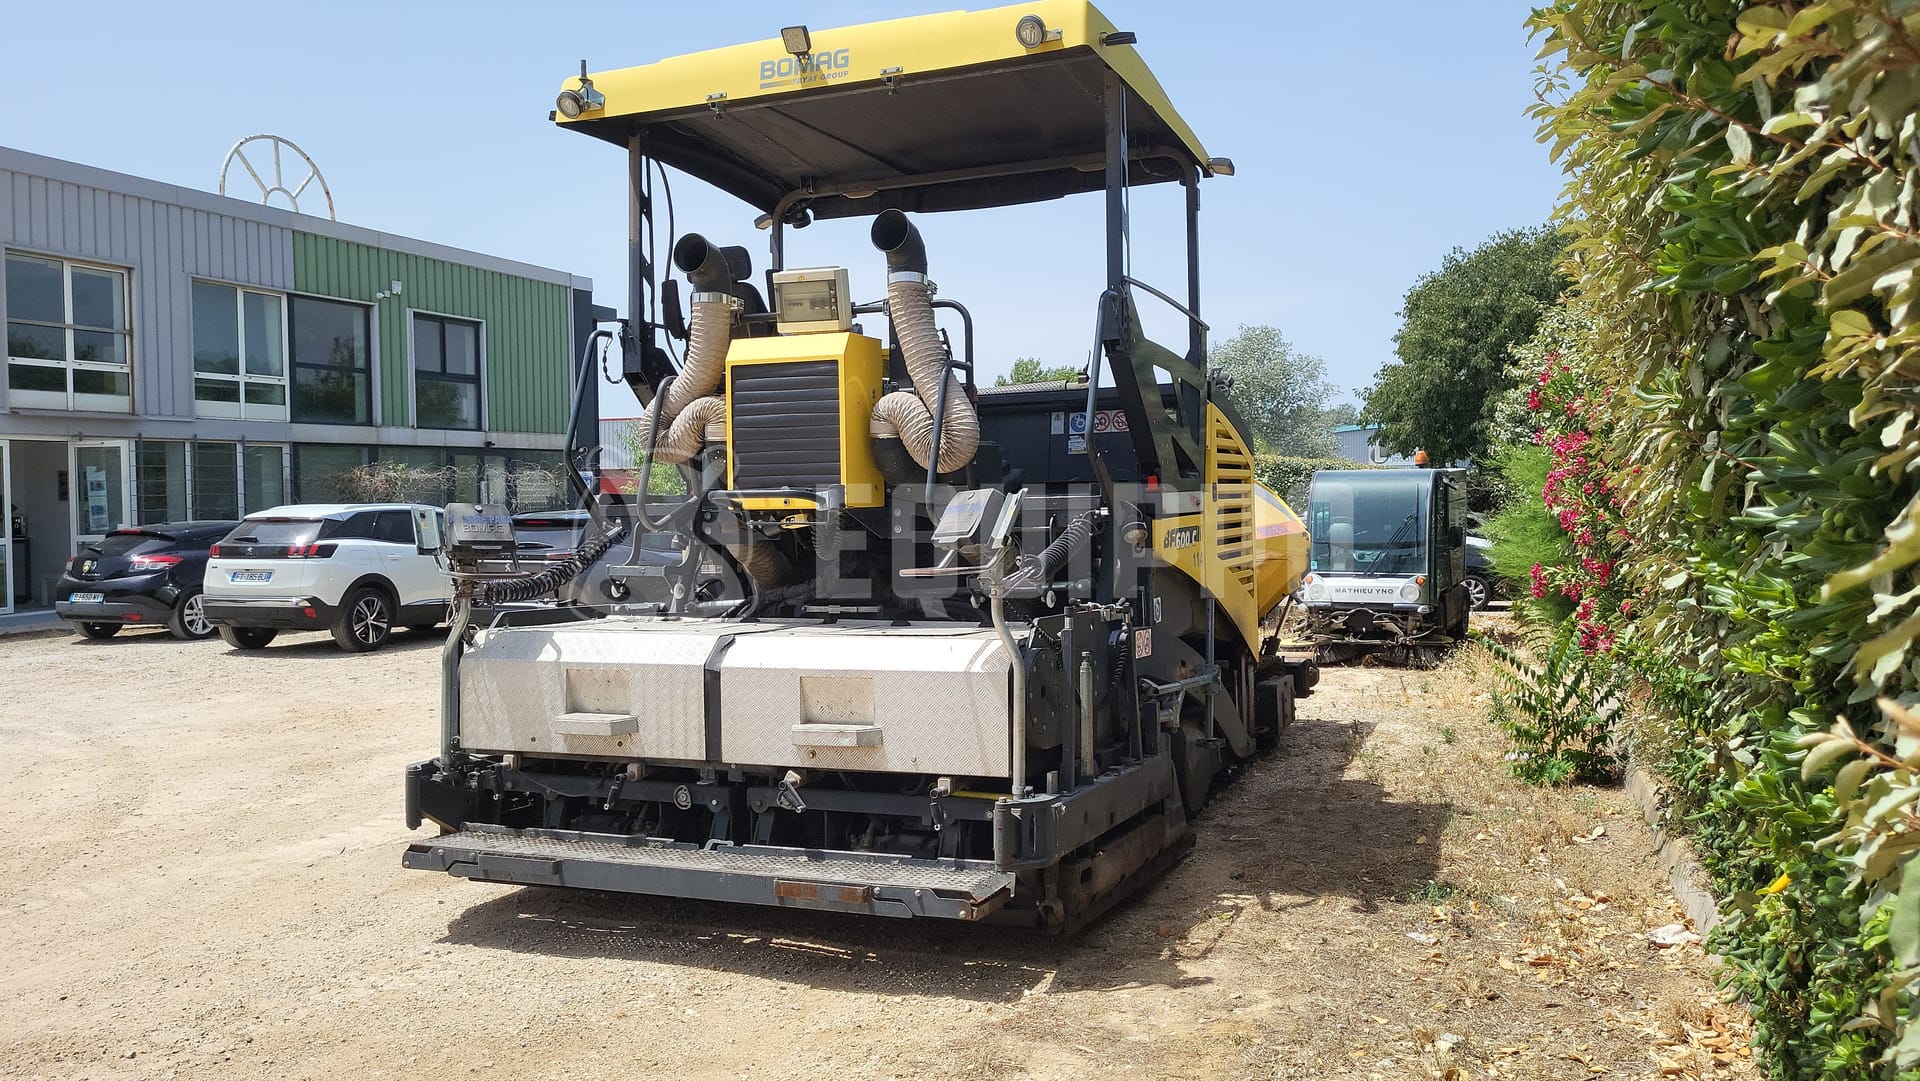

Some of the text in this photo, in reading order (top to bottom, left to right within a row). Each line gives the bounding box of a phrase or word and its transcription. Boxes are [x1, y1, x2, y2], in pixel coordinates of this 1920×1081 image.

[760, 48, 849, 81] BOMAG
[820, 71, 849, 81] GROUP
[1375, 587, 1394, 595] YNO
